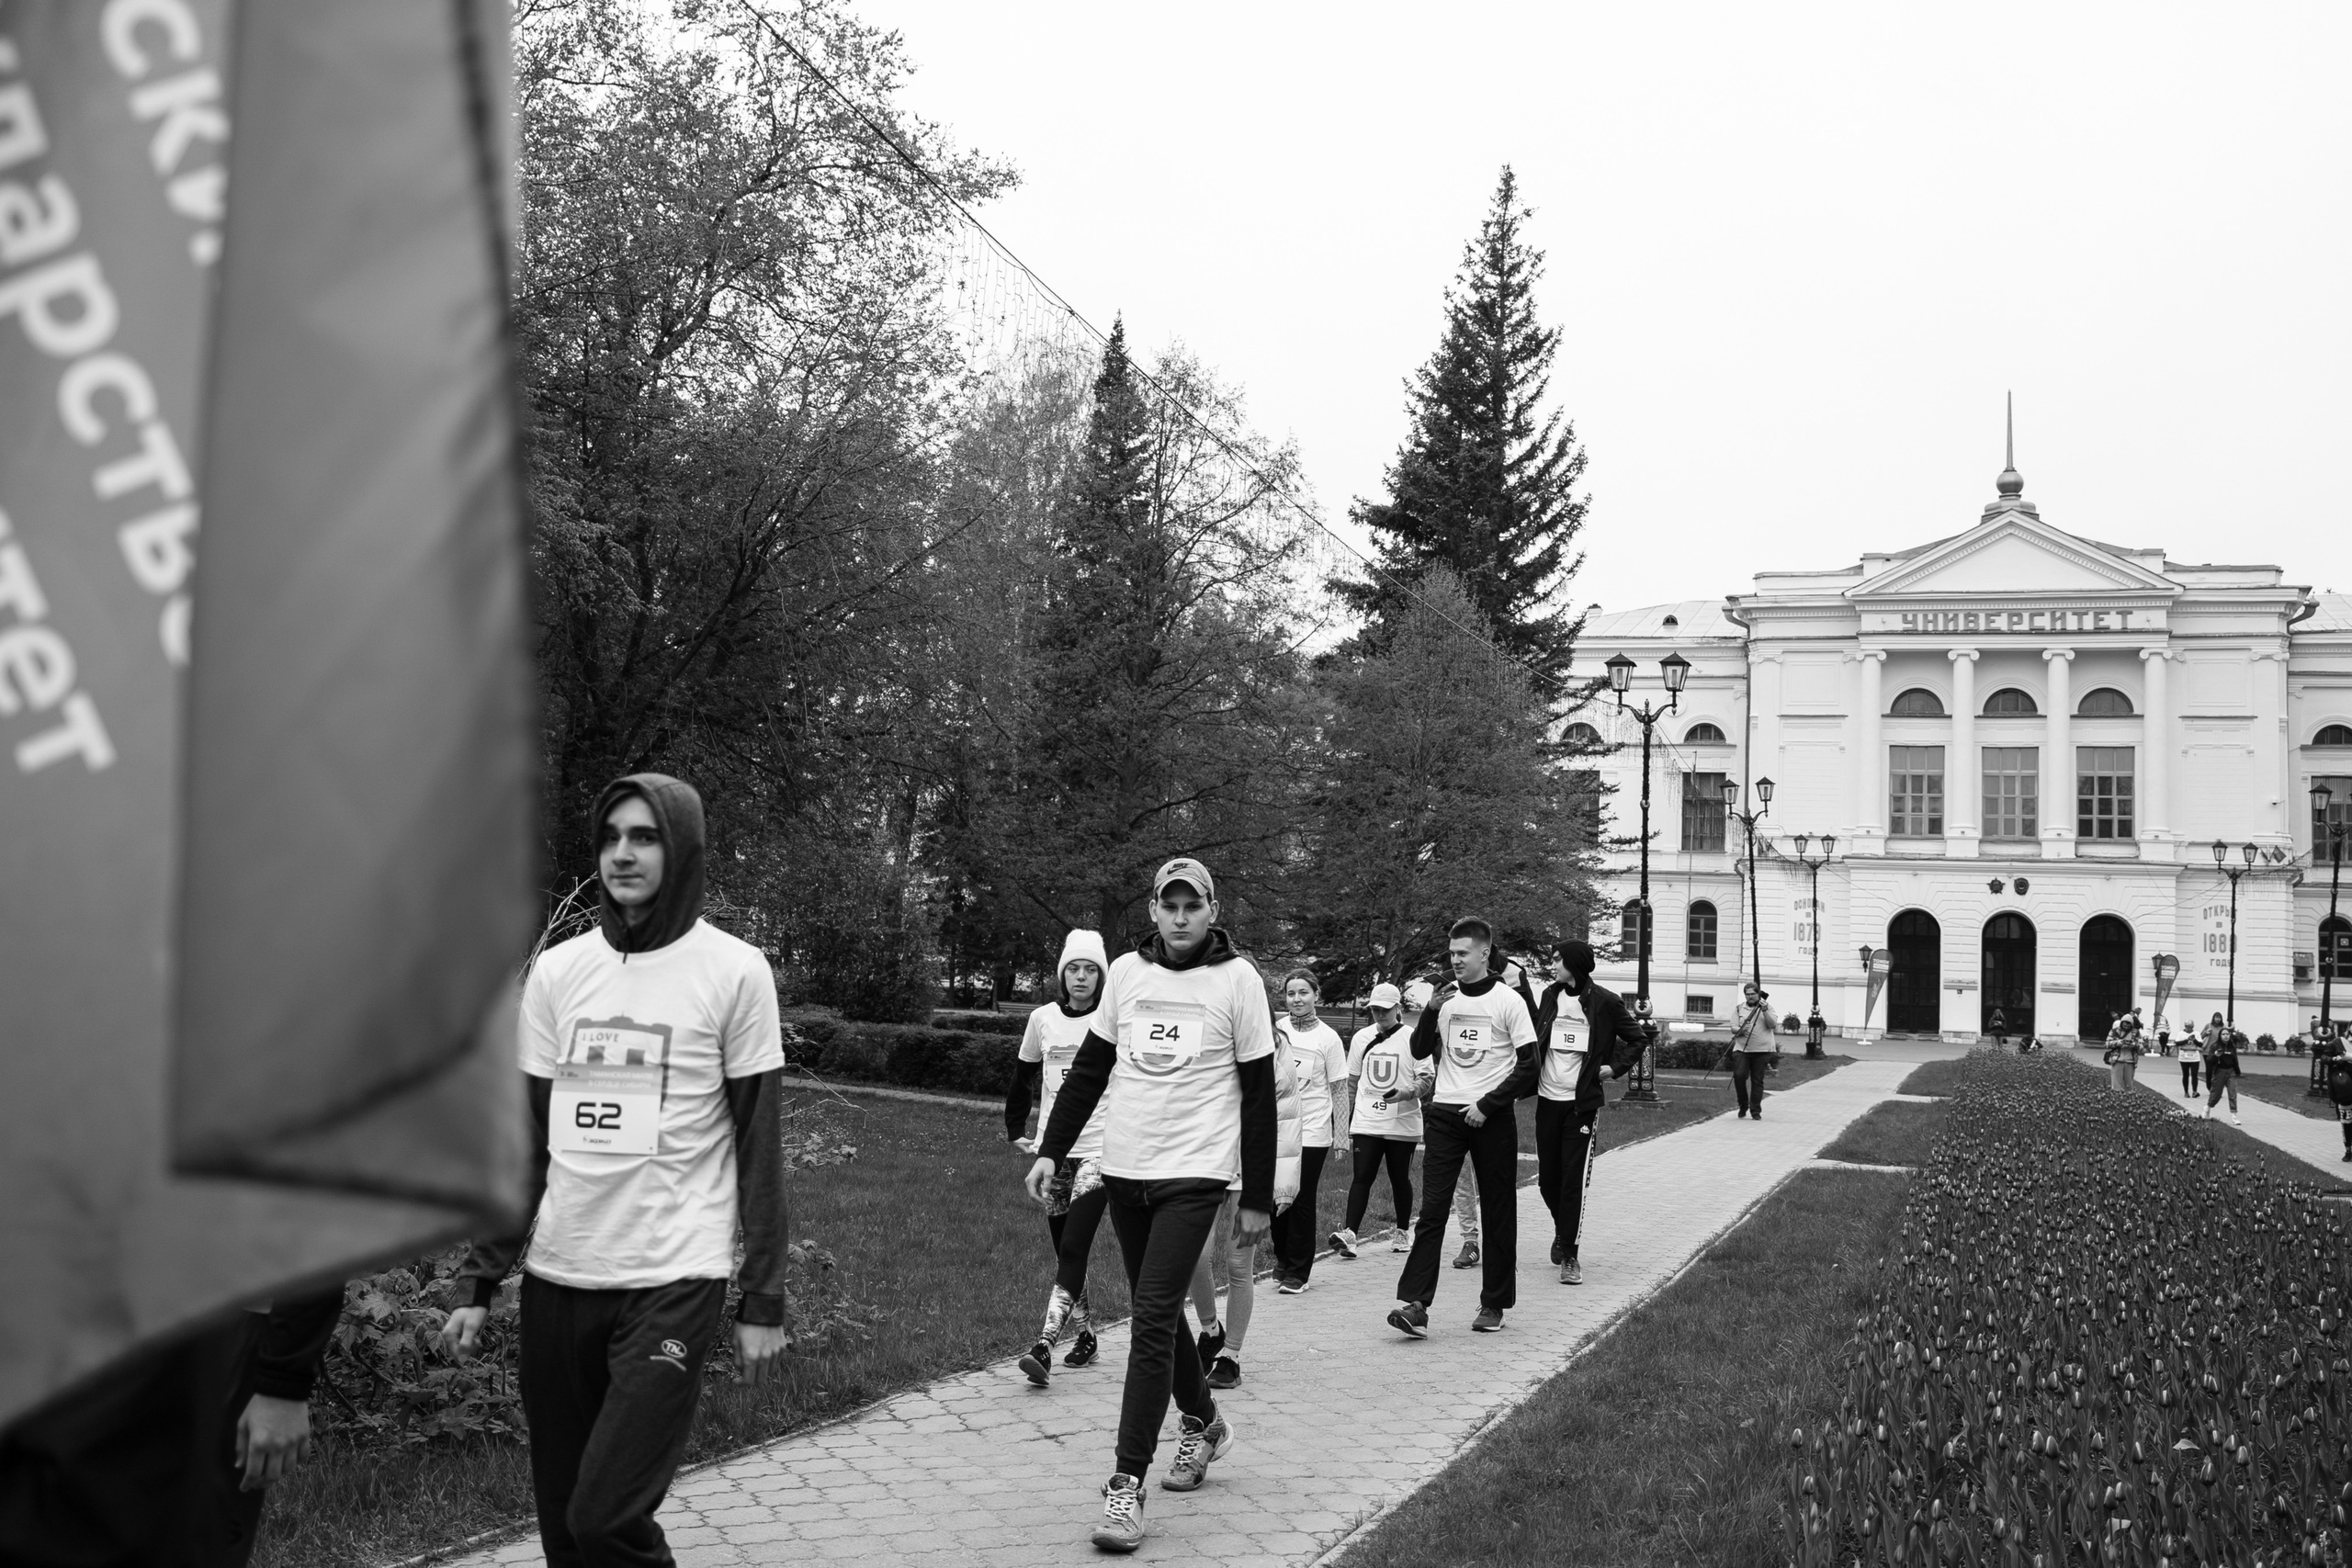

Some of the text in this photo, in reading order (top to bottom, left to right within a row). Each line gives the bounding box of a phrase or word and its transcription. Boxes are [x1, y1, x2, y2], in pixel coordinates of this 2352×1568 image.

[1901, 610, 2133, 631] УНИВЕРСИТЕТ
[1794, 897, 1826, 913] ОСНОАН
[2203, 905, 2237, 919] ОТКРЫ
[1798, 946, 1817, 955] ГОД
[590, 1032, 620, 1043] LOVE
[1149, 1023, 1180, 1042] 24
[1459, 1029, 1478, 1041] 42
[1563, 1033, 1576, 1043] 18
[1372, 1101, 1387, 1111] 49
[575, 1101, 622, 1130] 62
